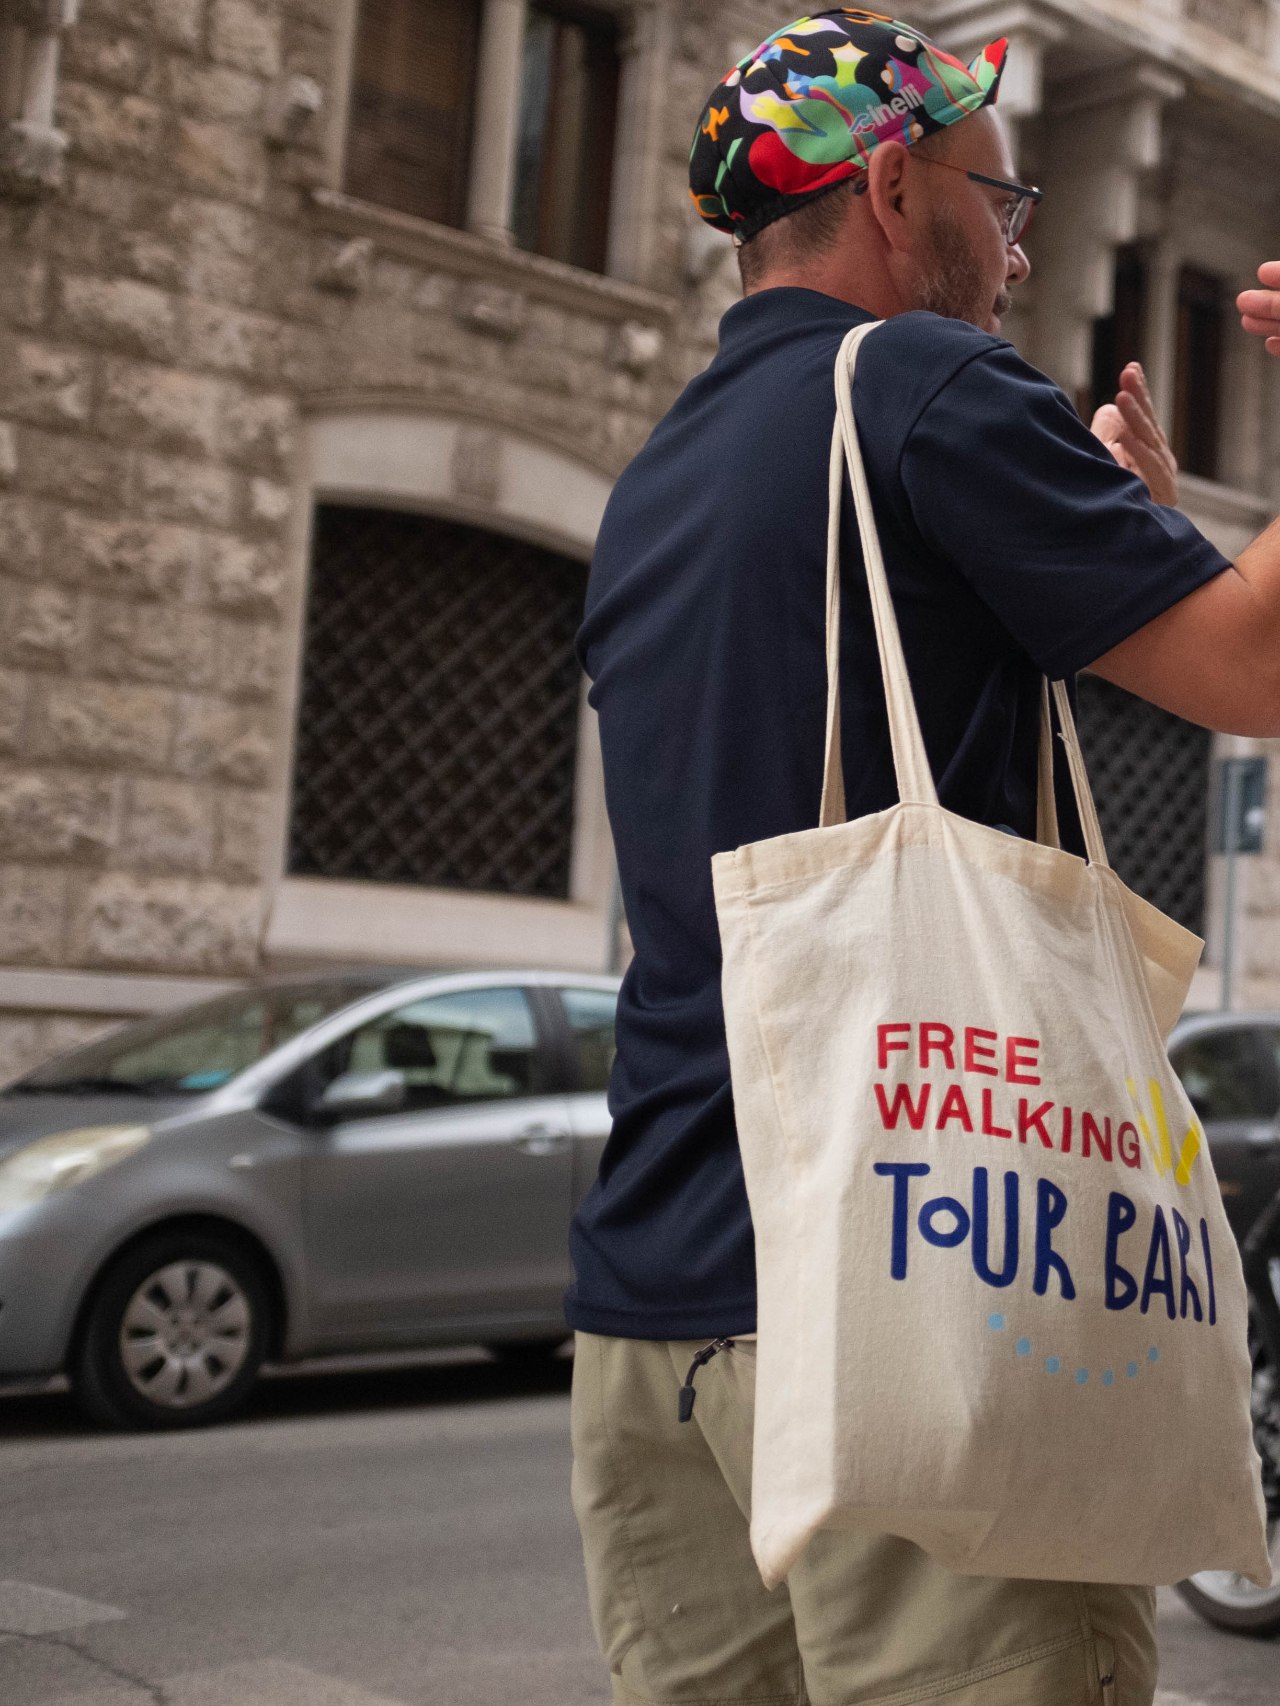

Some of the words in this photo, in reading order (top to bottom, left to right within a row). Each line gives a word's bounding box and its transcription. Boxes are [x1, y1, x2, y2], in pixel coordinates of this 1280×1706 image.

[877, 1021, 1041, 1086] FREE
[873, 1082, 1142, 1169] WALKING
[1104, 1190, 1217, 1326] BARI
